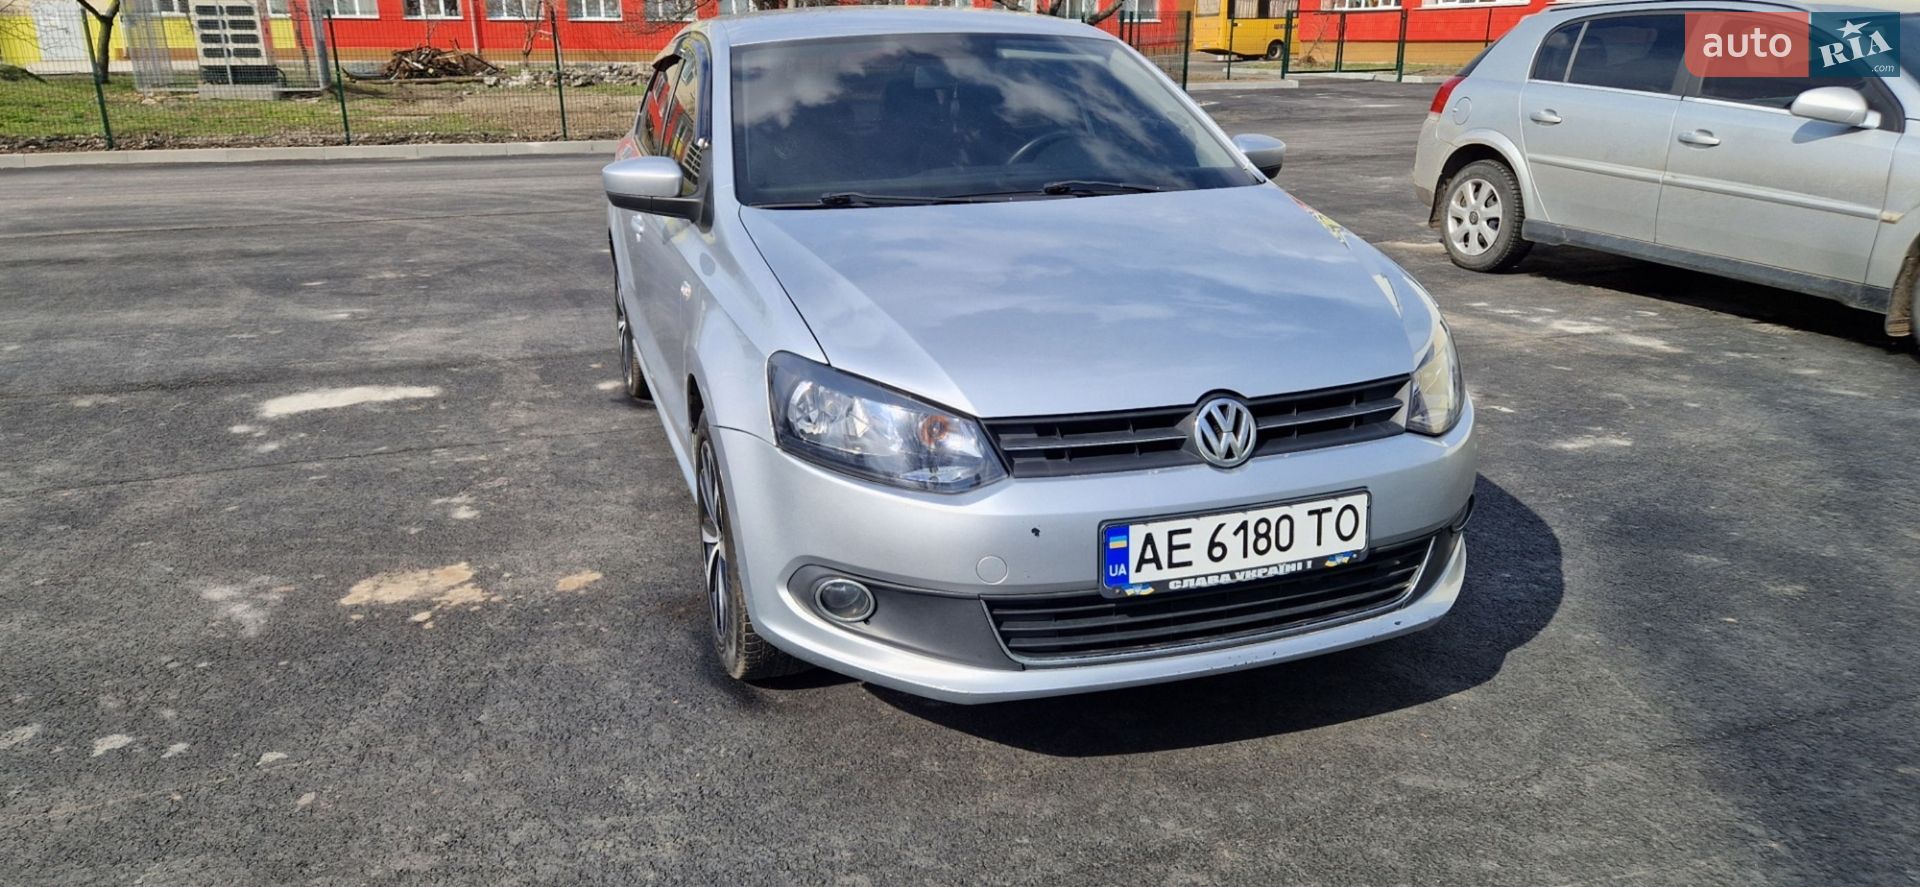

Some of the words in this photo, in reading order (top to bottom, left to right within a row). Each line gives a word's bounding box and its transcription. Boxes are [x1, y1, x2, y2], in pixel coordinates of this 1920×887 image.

[1135, 528, 1193, 573] AE
[1207, 514, 1294, 563] 6180
[1307, 504, 1360, 547] TO
[1109, 563, 1127, 577] UA
[1168, 573, 1231, 590] СЛАВА
